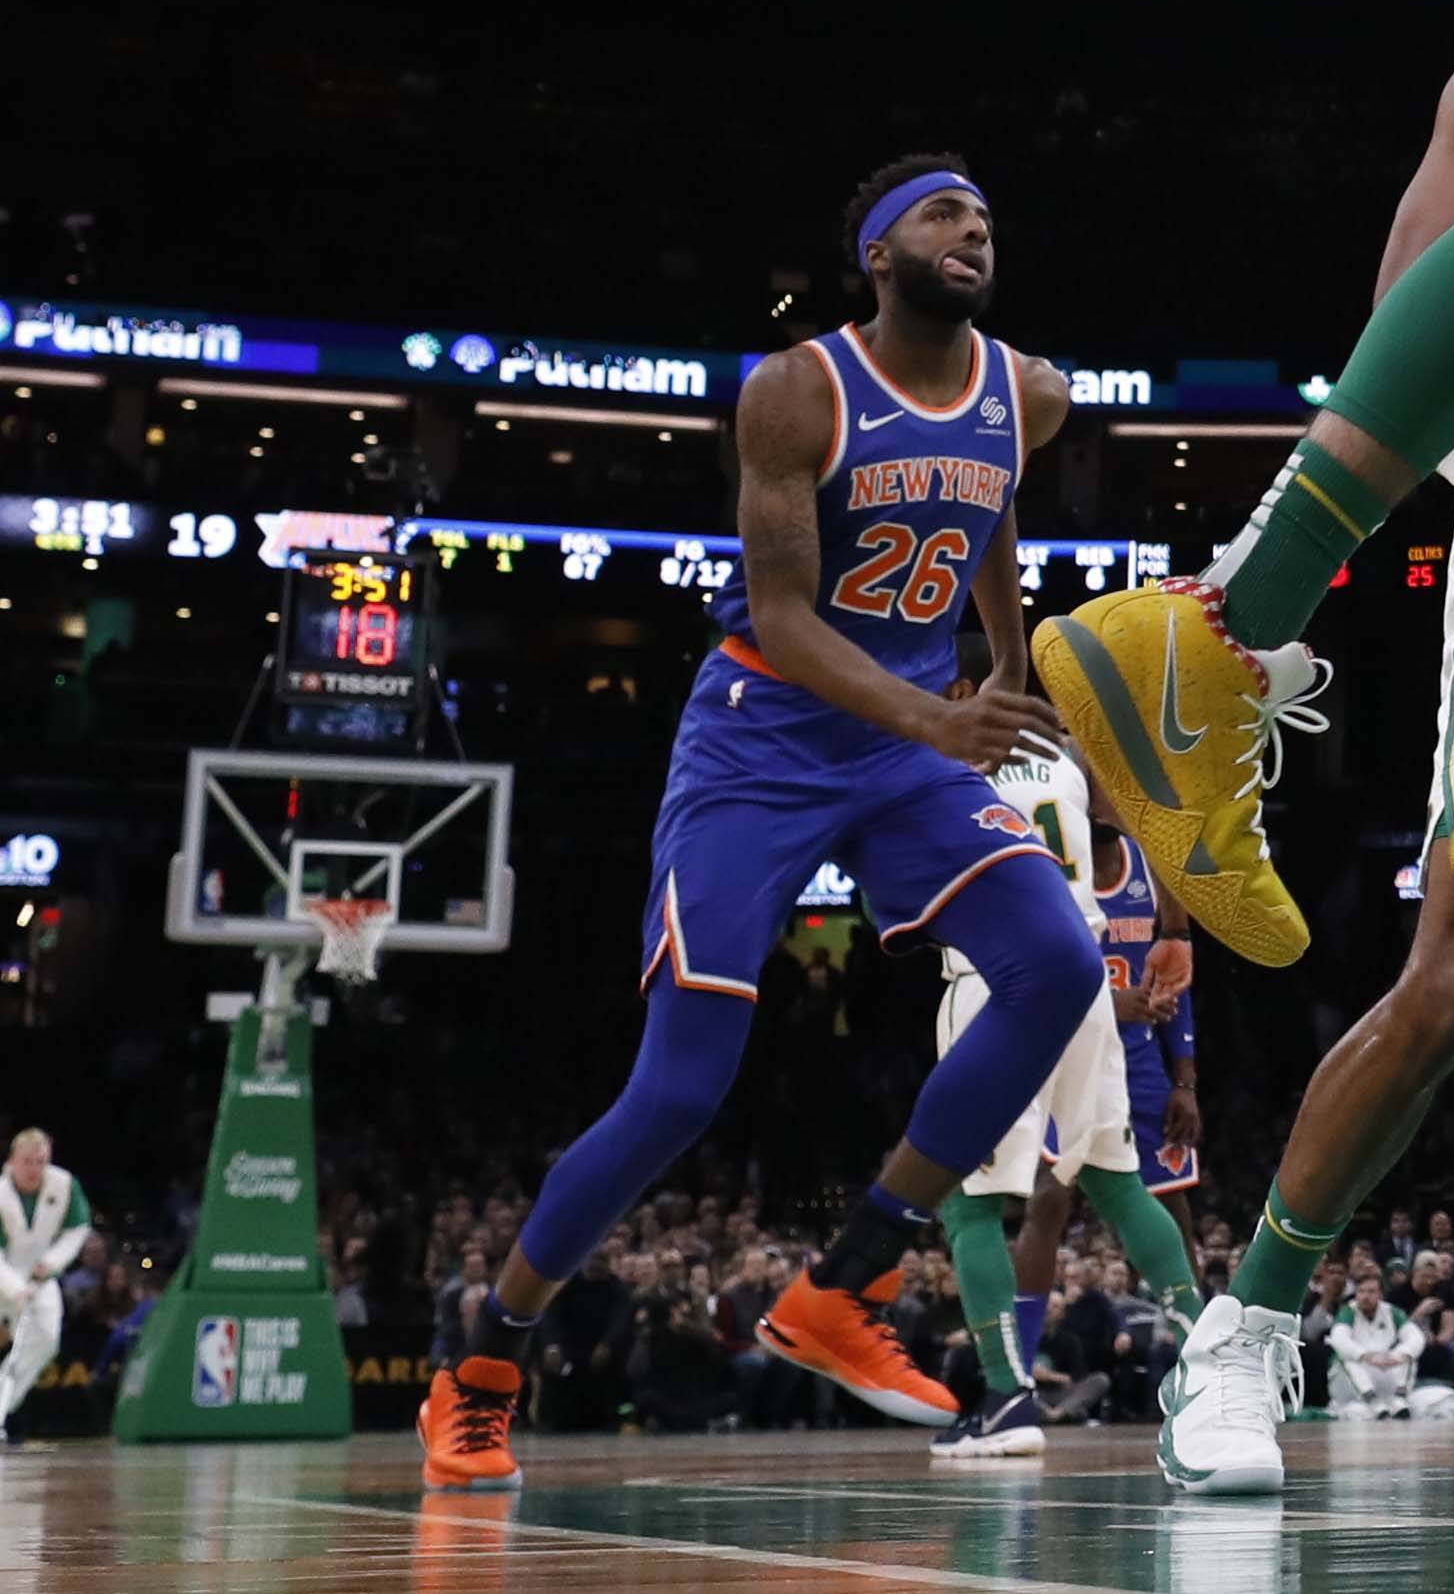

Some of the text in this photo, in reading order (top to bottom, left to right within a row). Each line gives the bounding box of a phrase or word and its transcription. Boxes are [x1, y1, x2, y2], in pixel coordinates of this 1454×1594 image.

[848, 456, 1010, 511] NEW YORK
[167, 511, 237, 558] 19
[331, 562, 413, 603] 3:51
[830, 521, 970, 623] 26
[1406, 565, 1435, 588] 25
[336, 601, 399, 666] 18
[325, 674, 414, 697] TISSOT
[8, 833, 60, 876] 10
